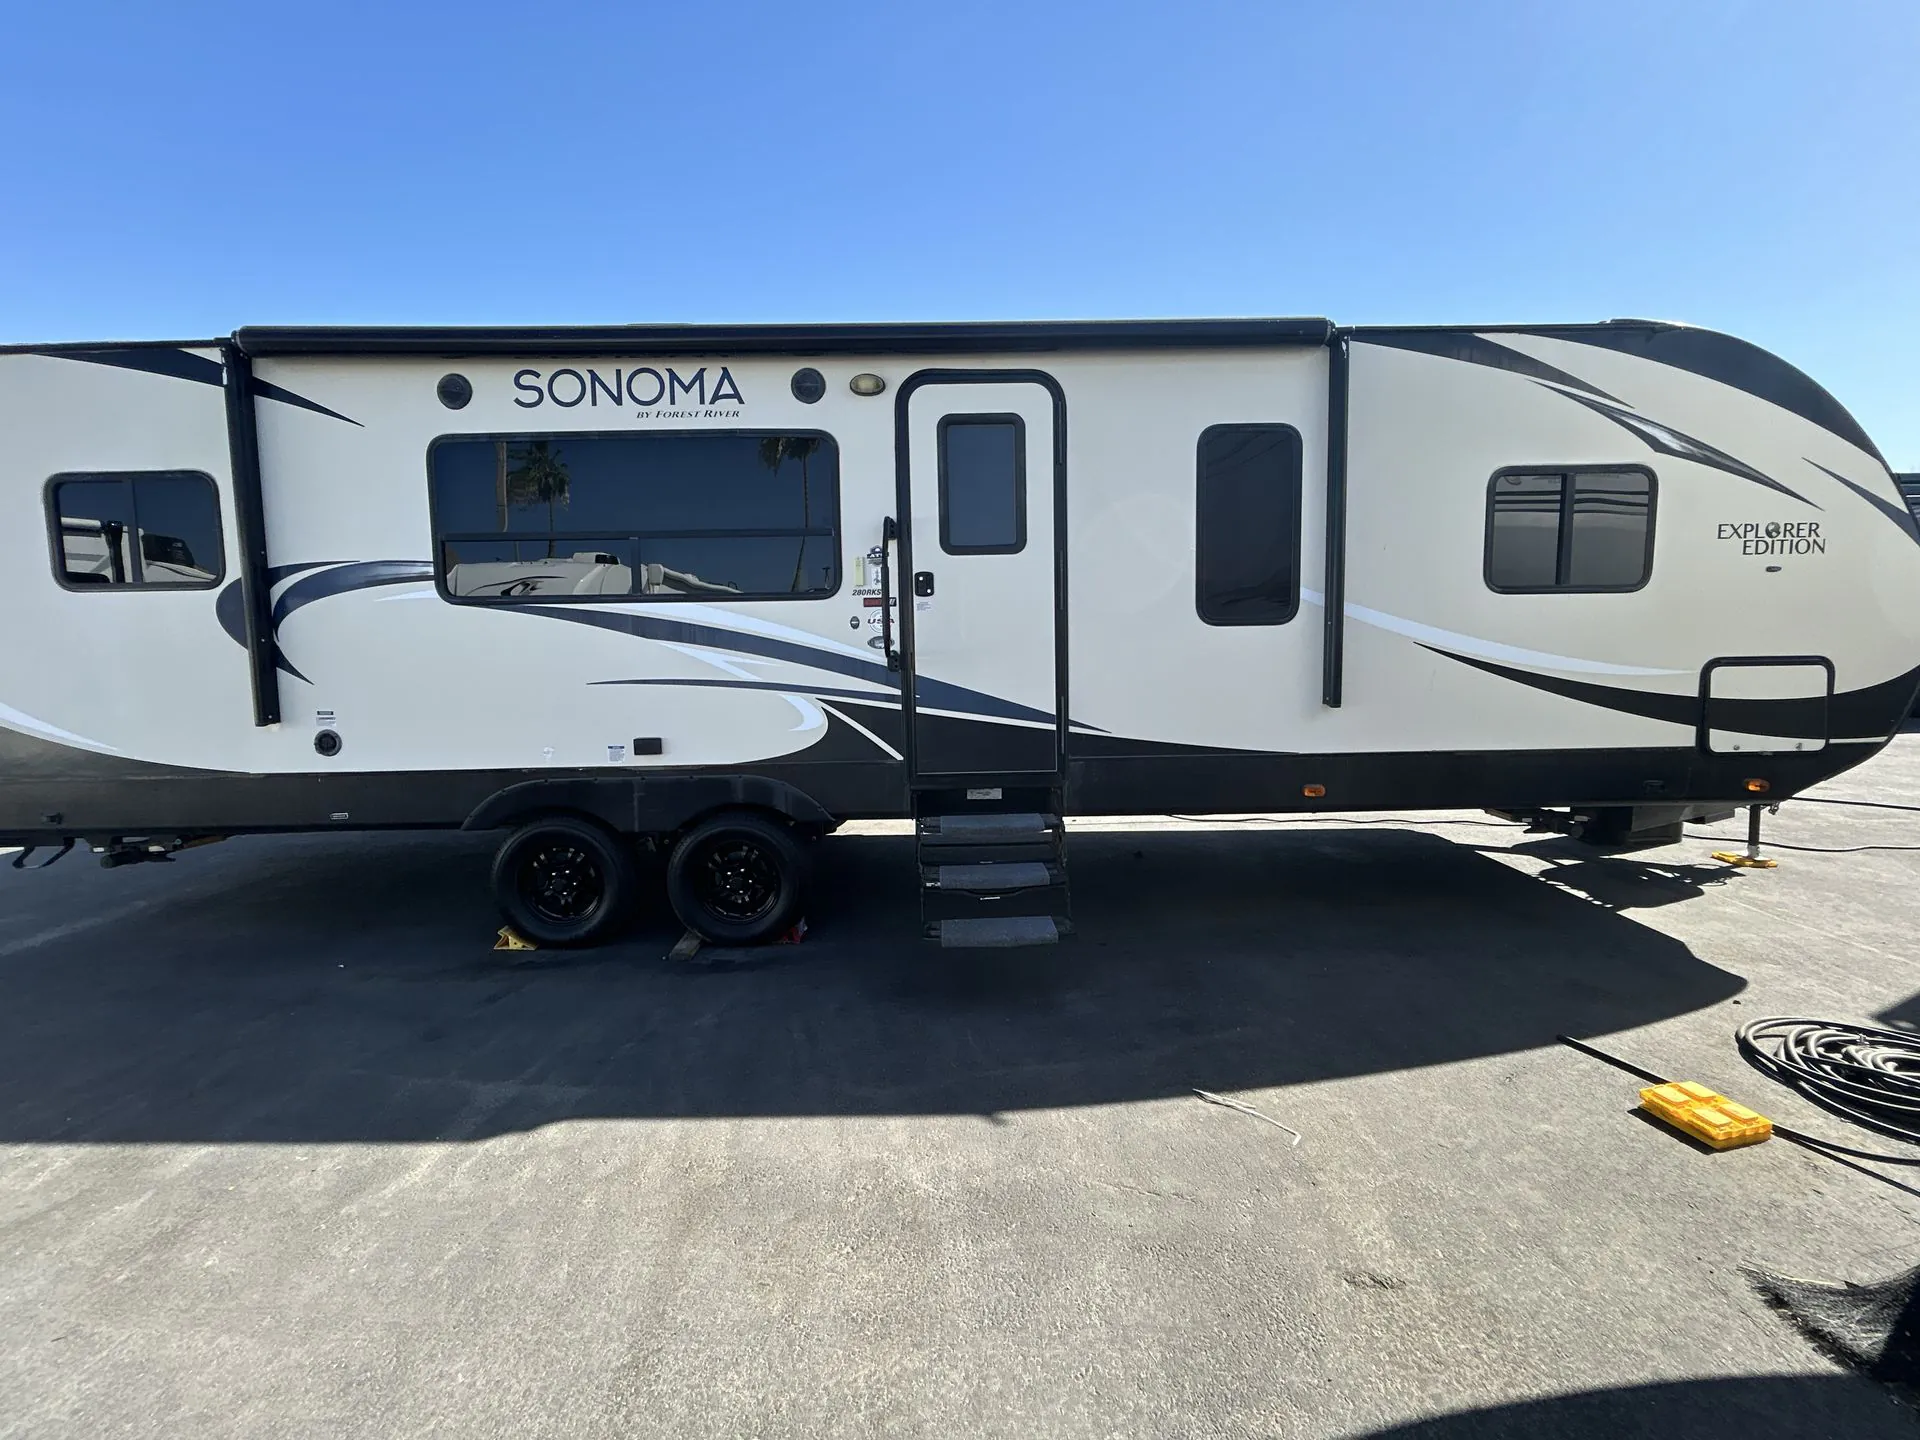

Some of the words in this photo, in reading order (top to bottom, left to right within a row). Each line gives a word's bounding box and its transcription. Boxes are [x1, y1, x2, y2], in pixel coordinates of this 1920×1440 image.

[513, 366, 746, 409] SONOMA
[636, 411, 652, 419] BY
[655, 410, 700, 419] FOREST
[703, 409, 740, 418] RIVER
[1717, 521, 1821, 540] EXPLORER
[1742, 538, 1826, 556] EDITION
